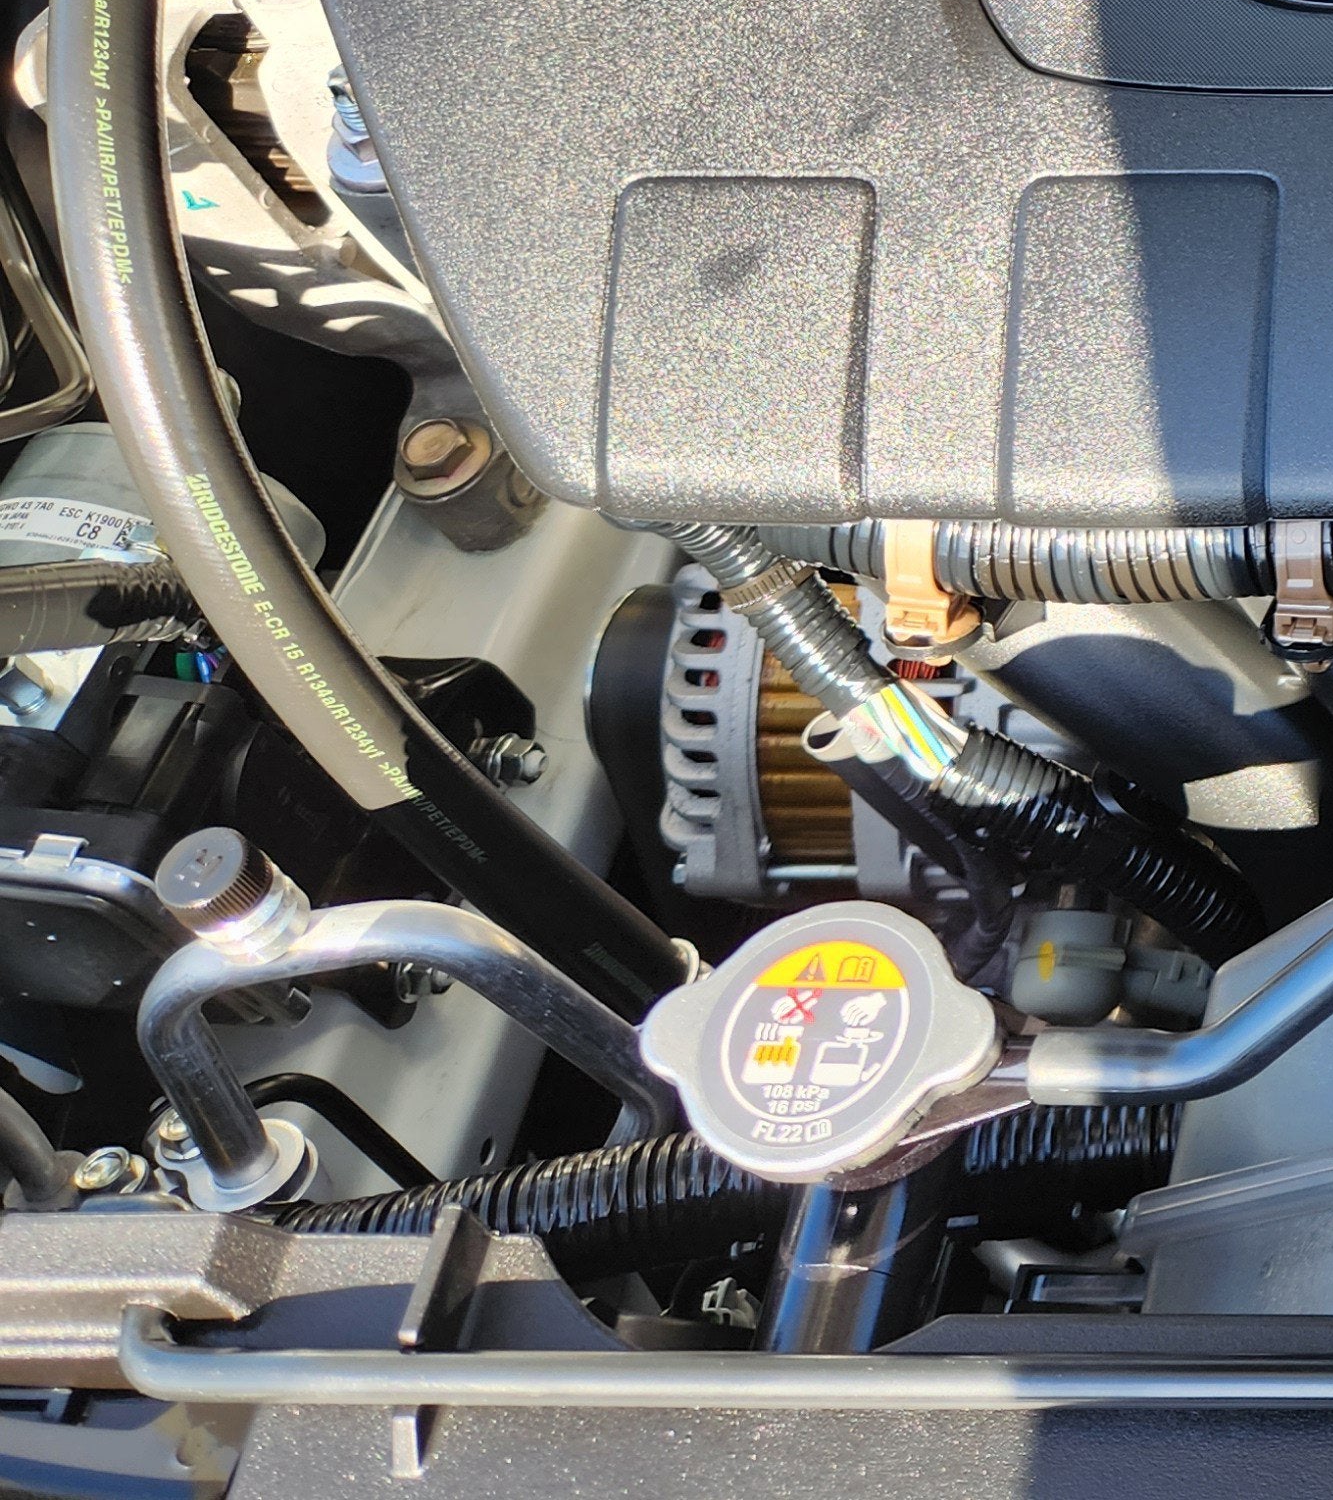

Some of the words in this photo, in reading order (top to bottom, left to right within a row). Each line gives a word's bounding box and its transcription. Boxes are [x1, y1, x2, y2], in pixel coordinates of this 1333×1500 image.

[95, 97, 134, 285] >PA/IIR/PET/EPDM<
[58, 506, 83, 519] ESC
[85, 510, 123, 529] K1900
[76, 522, 102, 540] C8
[185, 473, 266, 596] BRIDGESTONE
[253, 599, 291, 640] E-CR
[282, 641, 305, 661] 15
[296, 662, 386, 759] R134a/R1234yf
[762, 1083, 794, 1100] 108
[795, 1083, 831, 1100] kPa
[767, 1099, 790, 1115] 16
[790, 1099, 821, 1116] psi
[750, 1118, 804, 1144] FL22
